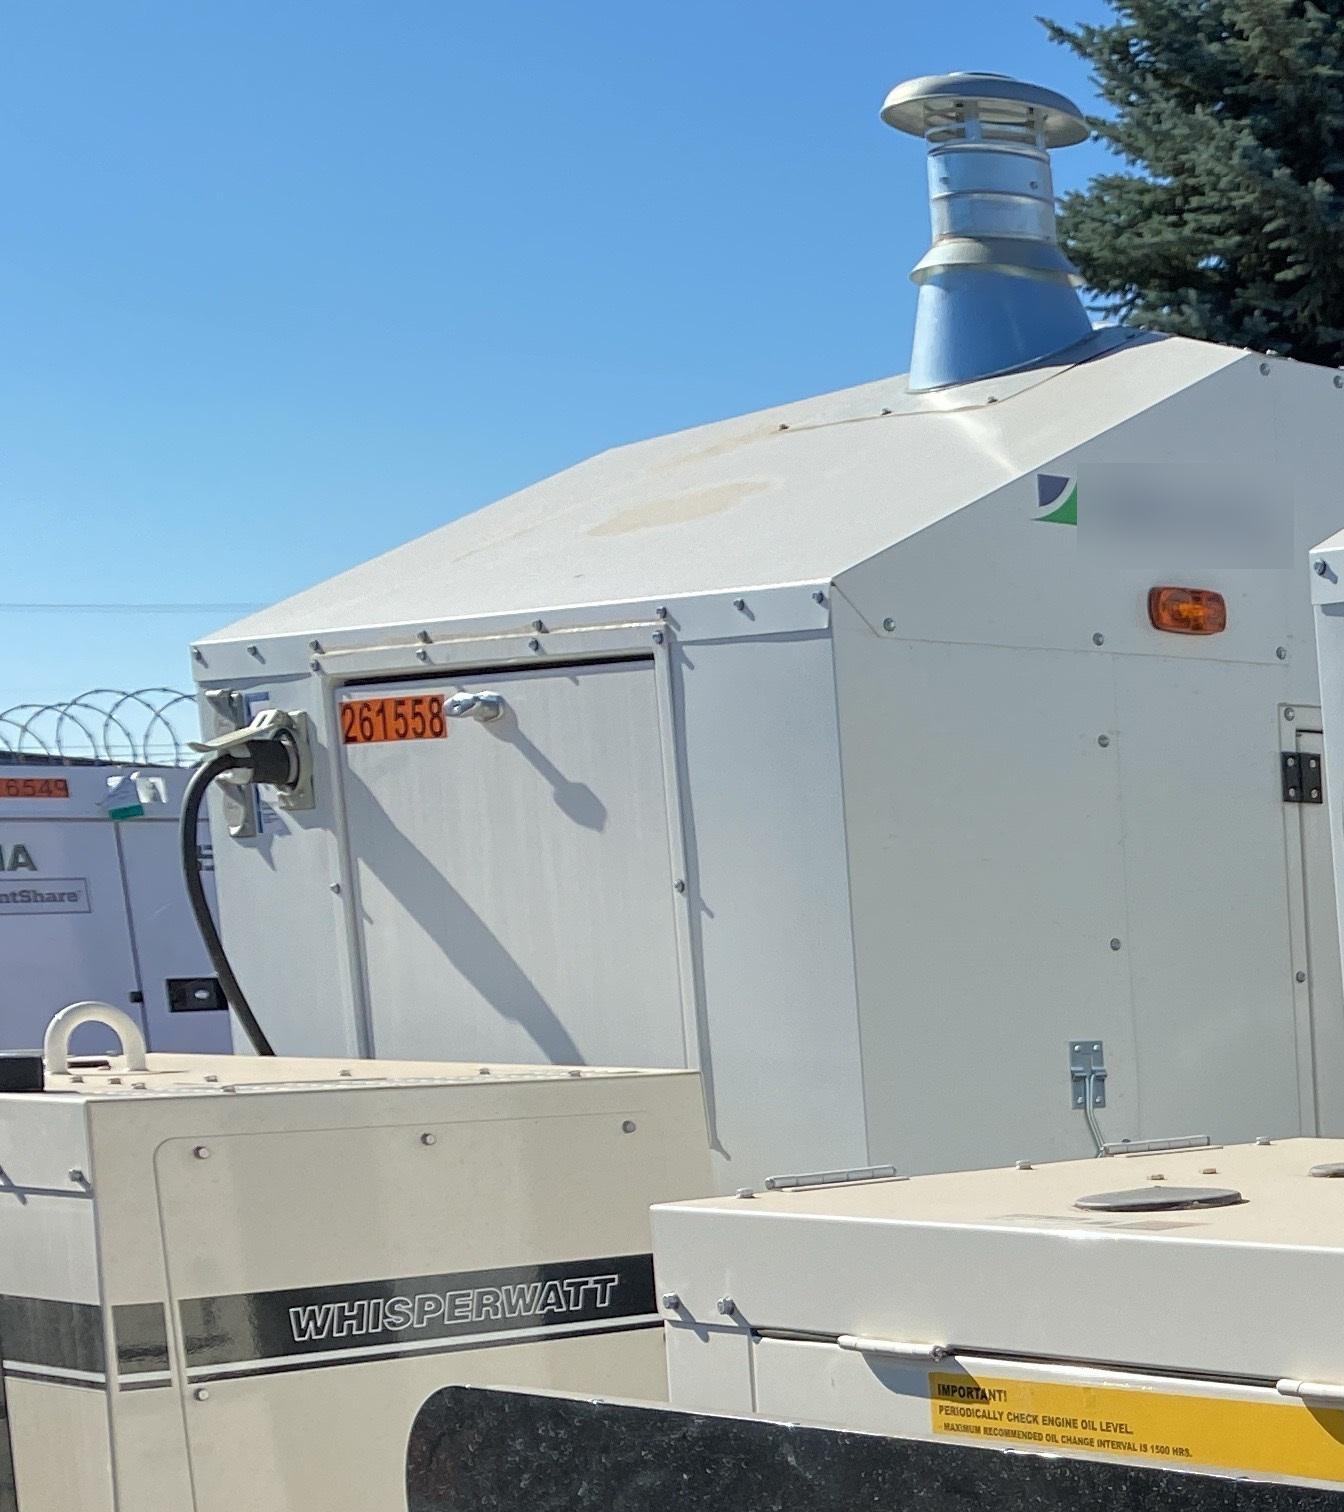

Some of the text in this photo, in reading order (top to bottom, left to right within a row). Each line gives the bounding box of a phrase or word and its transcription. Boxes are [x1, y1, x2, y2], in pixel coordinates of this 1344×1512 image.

[344, 697, 445, 743] 261558
[288, 1274, 619, 1342] WHISPERWATT
[937, 1383, 1008, 1402] IMPORTANT!
[938, 1404, 1134, 1435] PERIODICALLY CHECK ENGINE OIL LEVEL.
[943, 1422, 982, 1434] MAXIMUM
[983, 1426, 1044, 1442] RECOMMENDED
[1045, 1433, 1060, 1444] OIL
[1060, 1435, 1095, 1449] CHANGE
[1096, 1438, 1138, 1453] INTERVAL
[1139, 1443, 1148, 1453] IS
[1150, 1444, 1171, 1455] 1500
